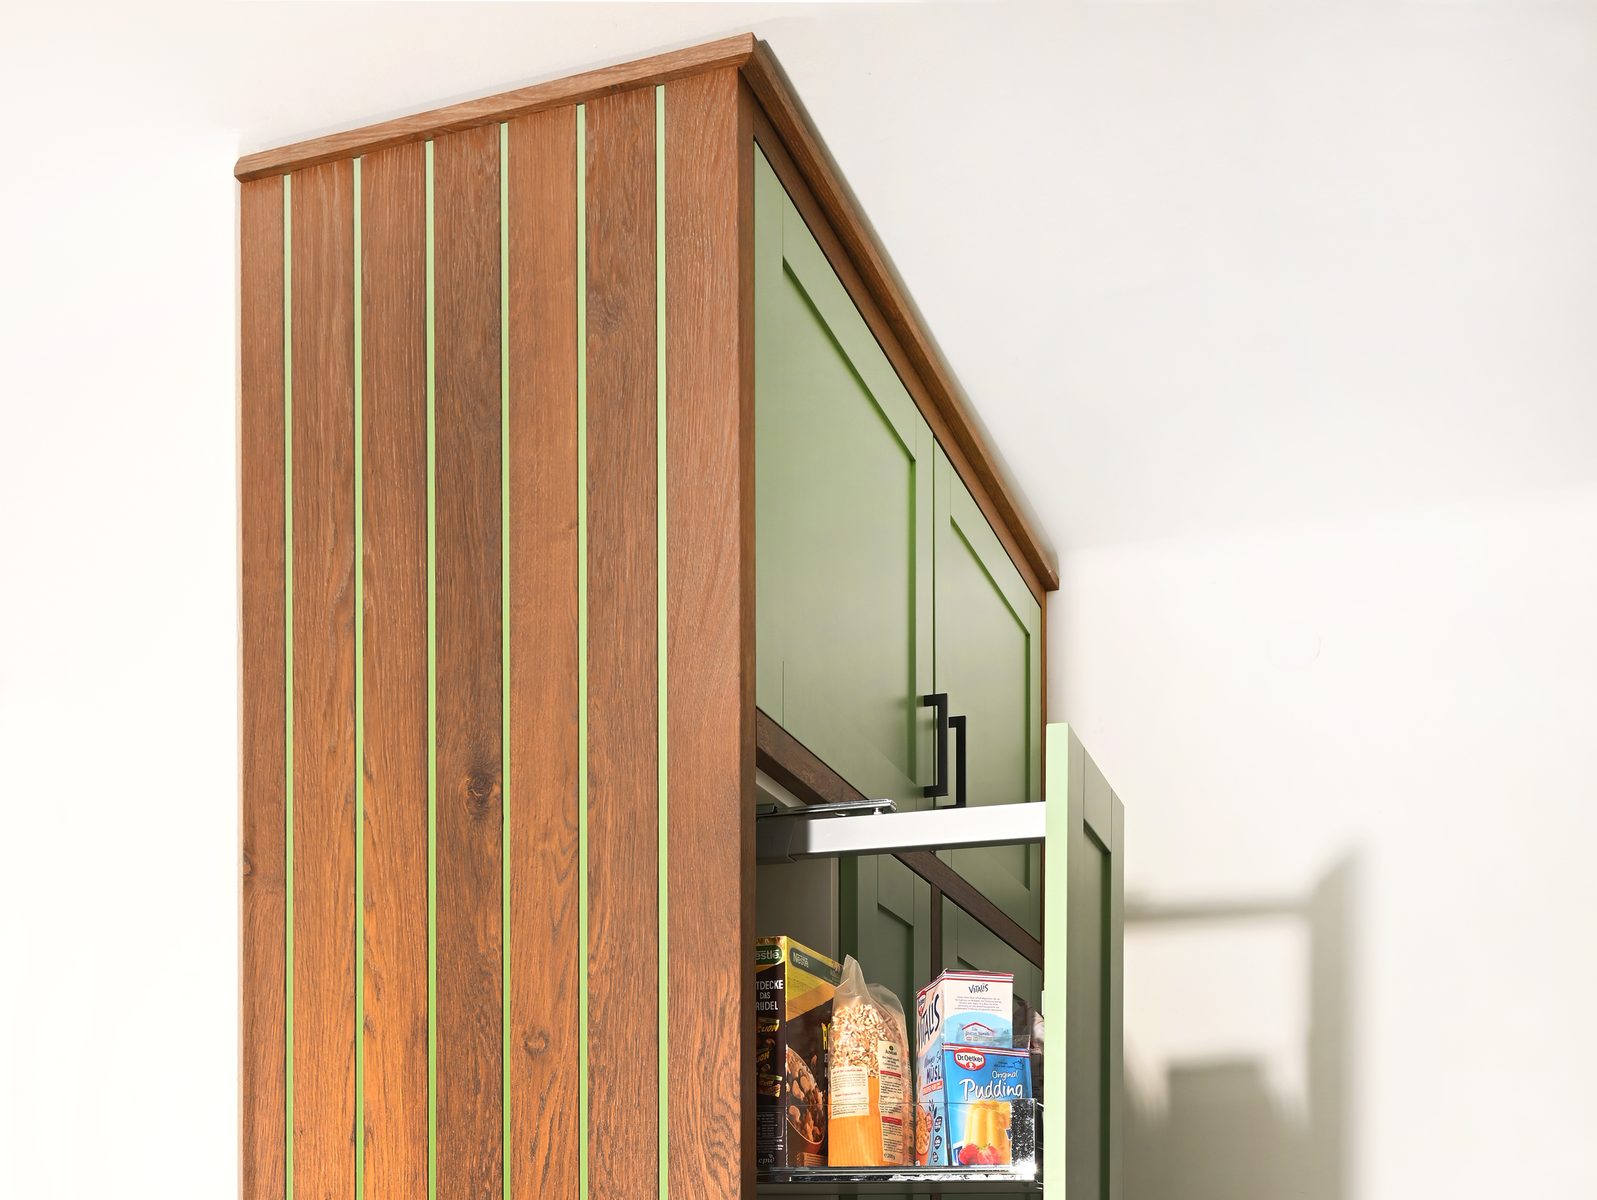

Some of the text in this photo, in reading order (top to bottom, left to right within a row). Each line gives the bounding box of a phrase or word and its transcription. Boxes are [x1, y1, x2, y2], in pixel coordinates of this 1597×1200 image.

[756, 949, 781, 960] estlé
[756, 979, 784, 990] TDECKE
[968, 983, 989, 994] VITALIS
[991, 1070, 1018, 1081] Original
[959, 1078, 1023, 1101] Pudding
